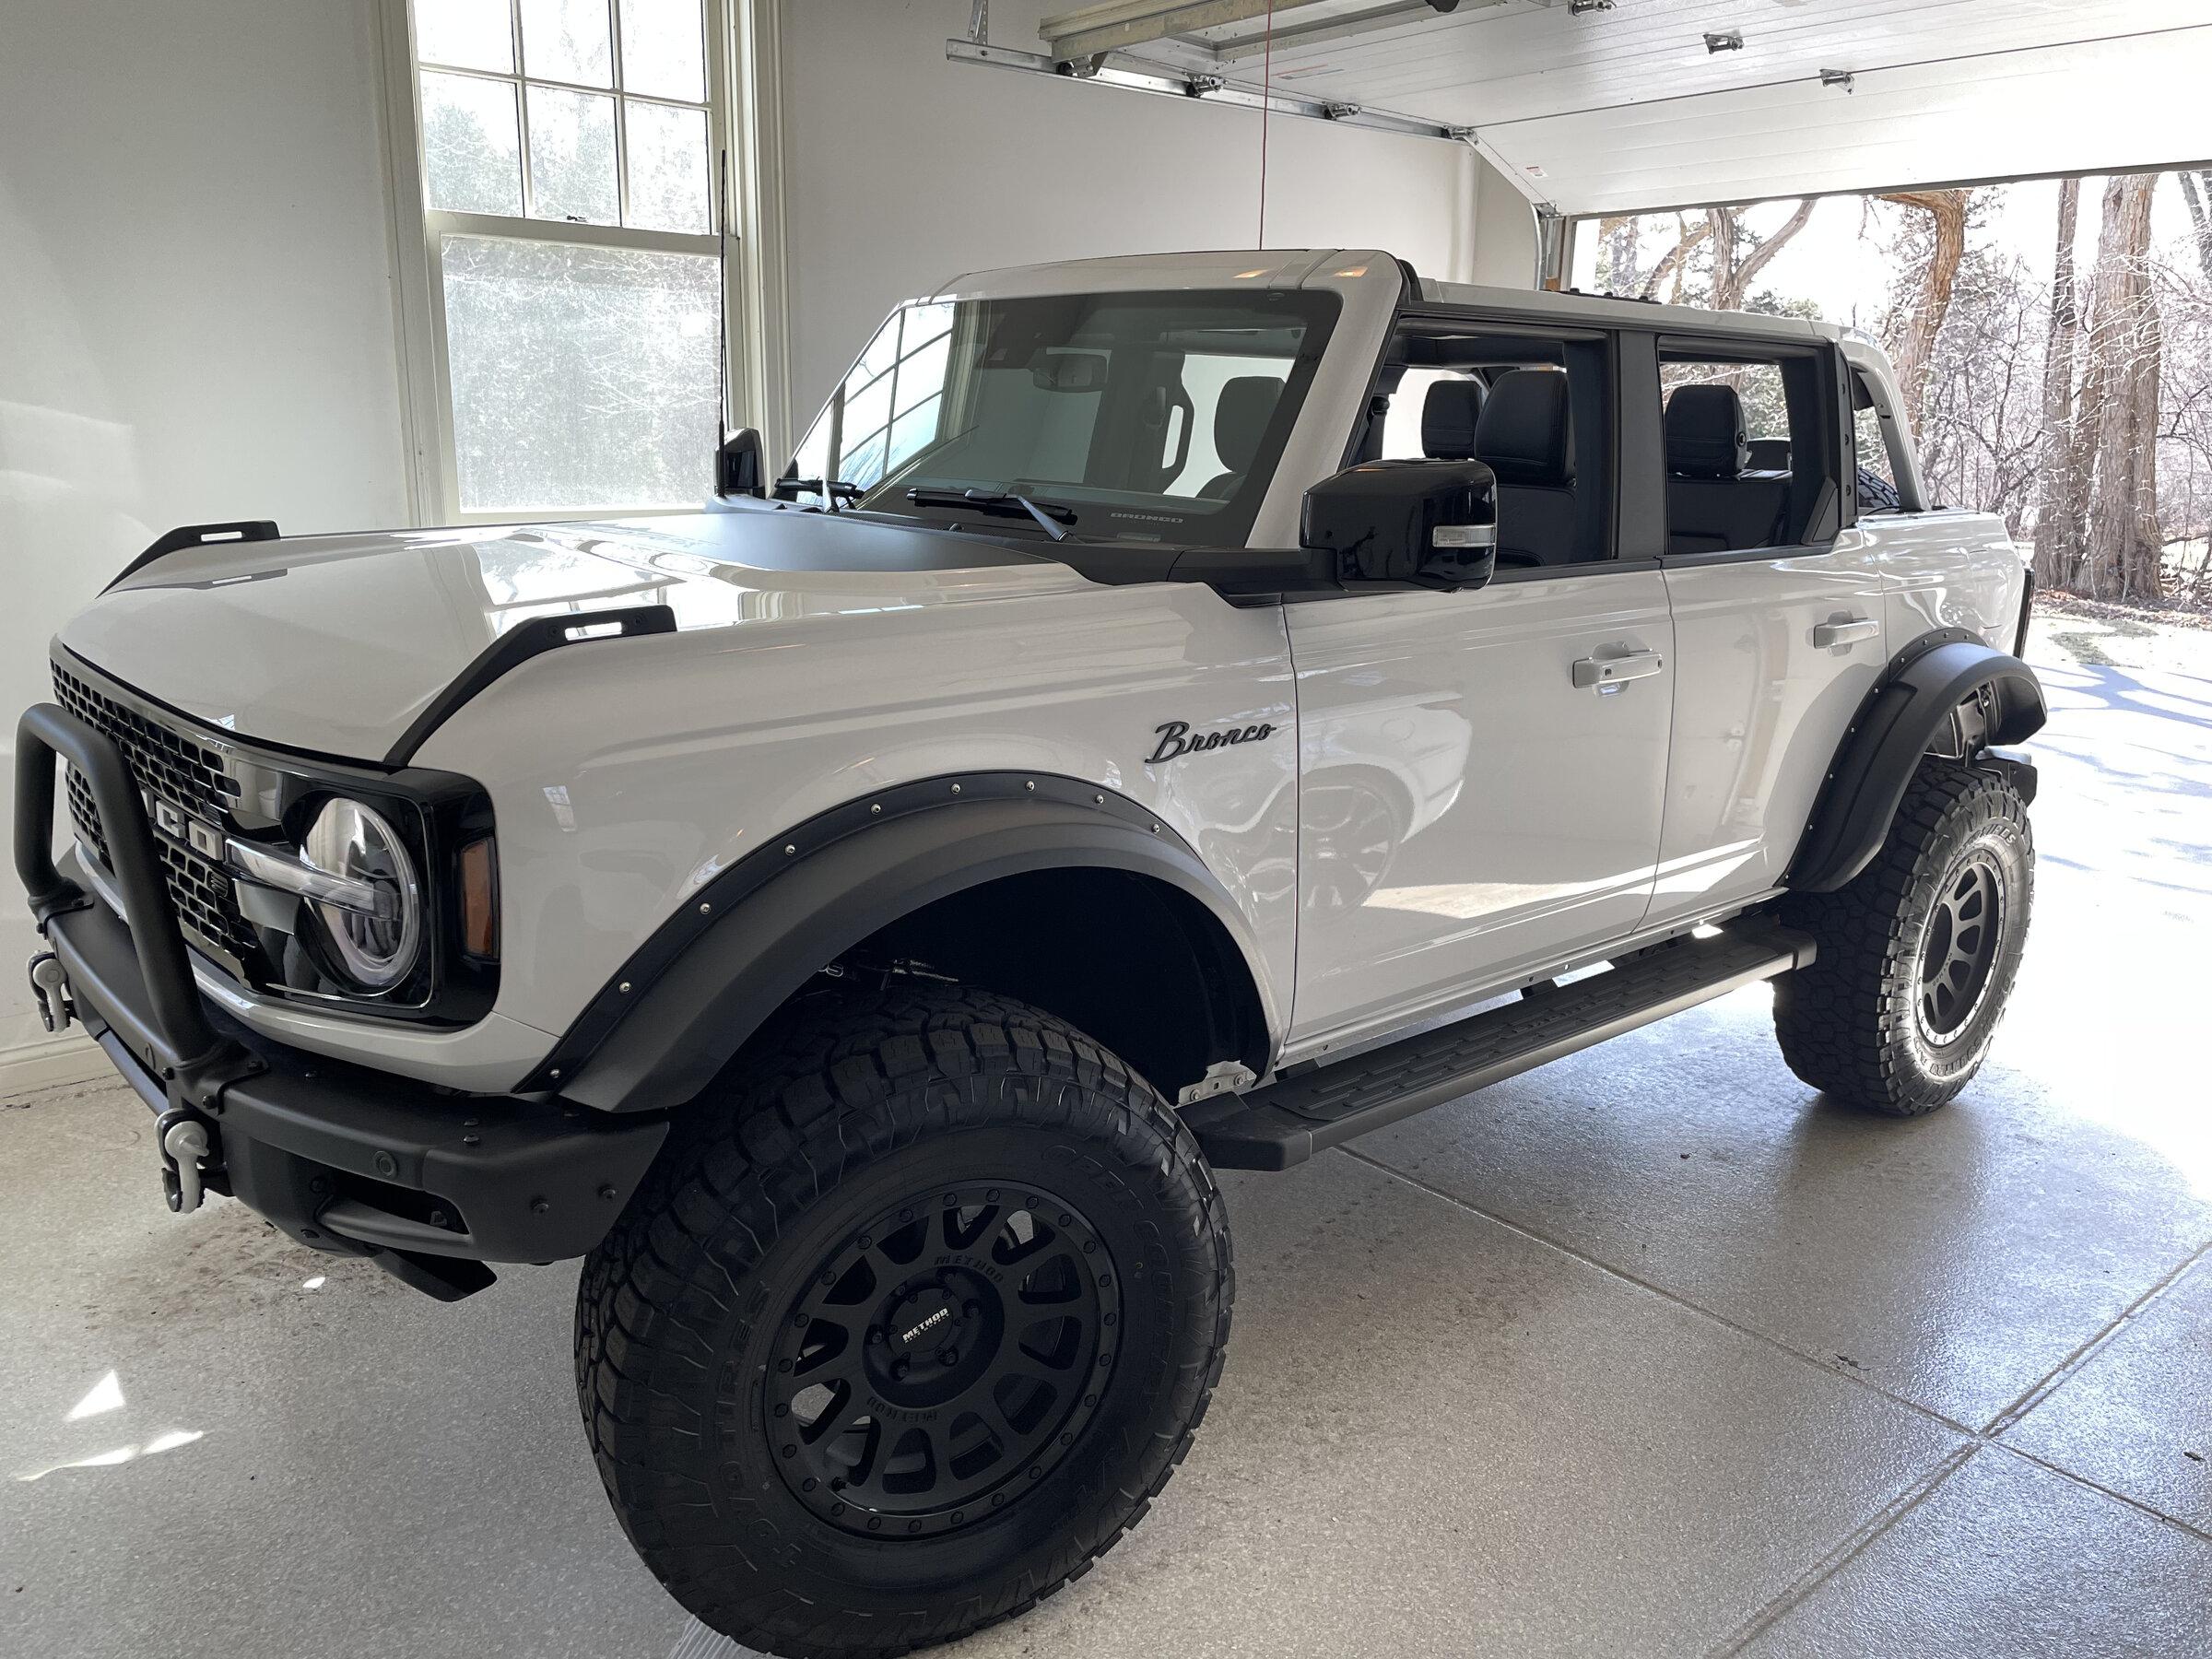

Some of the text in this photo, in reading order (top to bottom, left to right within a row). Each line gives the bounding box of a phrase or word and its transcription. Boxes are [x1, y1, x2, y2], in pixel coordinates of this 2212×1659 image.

[1111, 512, 1184, 524] BRONCO
[1145, 721, 1277, 764] Bronco
[933, 1253, 1004, 1284] METHOD
[902, 1307, 949, 1342] METHOD
